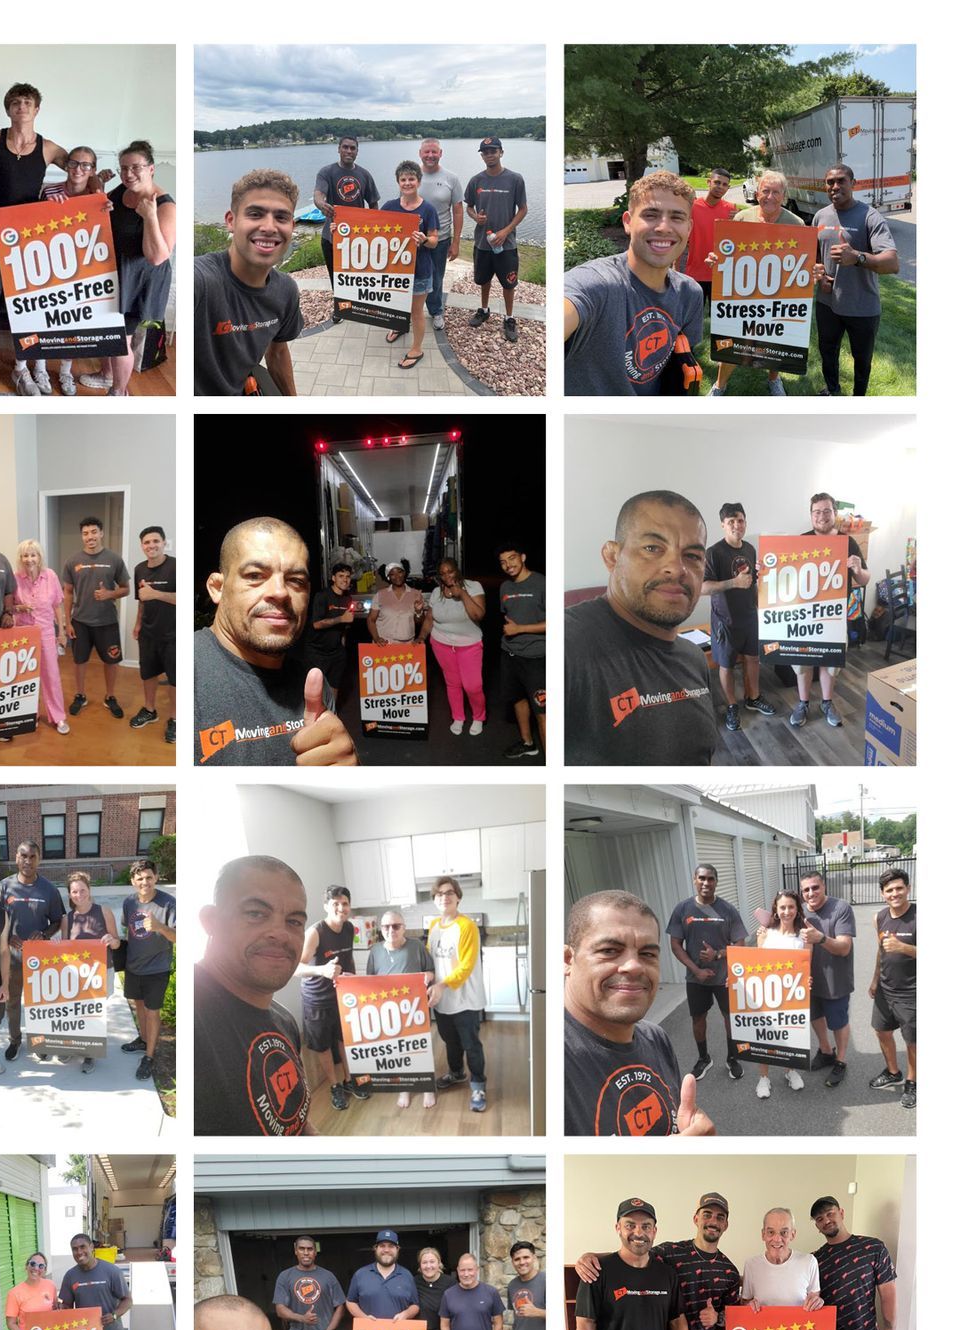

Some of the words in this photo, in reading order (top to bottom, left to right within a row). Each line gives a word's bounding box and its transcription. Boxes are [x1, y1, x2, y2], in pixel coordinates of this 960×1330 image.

[4, 223, 109, 290] 100%
[337, 236, 412, 270] 100%
[338, 272, 409, 288] Stress-Free
[718, 253, 810, 296] 100%
[12, 278, 113, 314] Stress-Free
[358, 288, 390, 302] Move
[45, 305, 92, 328] Move
[717, 300, 807, 318] Stress-Free
[742, 320, 783, 337] Move
[763, 559, 843, 604] 100%
[763, 603, 842, 624] Stress-Free
[787, 622, 823, 638] Move
[362, 662, 423, 694] 100%
[364, 694, 423, 708] Stress-Free
[382, 708, 409, 719] Move
[27, 961, 102, 1002] 100%
[732, 972, 805, 1009] 100%
[29, 1002, 102, 1019] Stress-Free
[344, 996, 425, 1041] 100%
[734, 1012, 805, 1026] Stress-Free
[51, 1019, 84, 1032] Move
[756, 1028, 788, 1041] Move
[351, 1037, 427, 1059] Stress-Free
[375, 1055, 410, 1071] Move
[615, 1073, 634, 1090] EST.
[634, 1071, 652, 1083] 1972
[634, 1106, 652, 1129] CT
